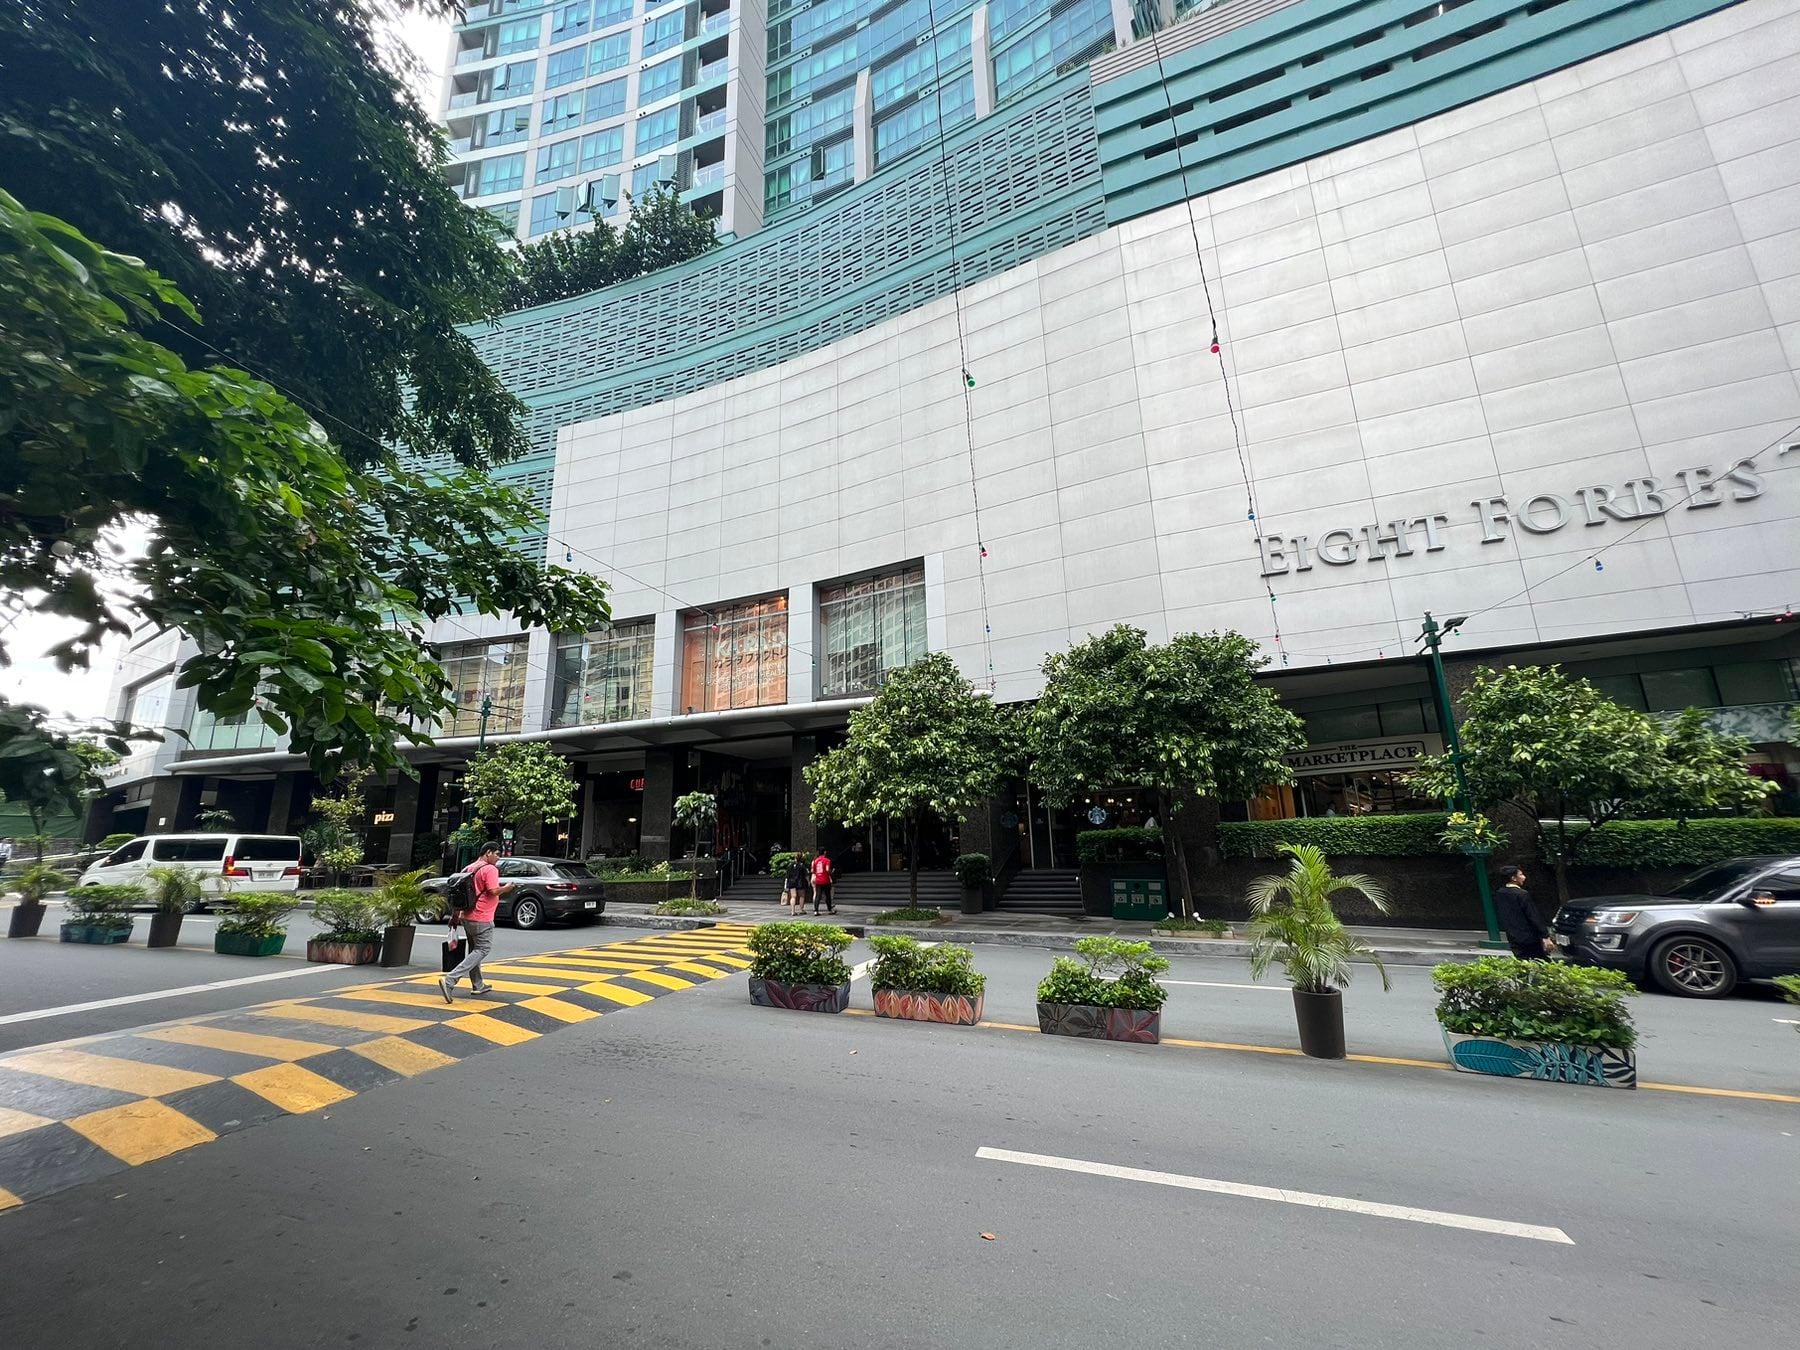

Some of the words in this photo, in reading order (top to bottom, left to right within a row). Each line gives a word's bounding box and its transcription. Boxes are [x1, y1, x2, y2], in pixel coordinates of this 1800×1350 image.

[1254, 513, 1449, 578] EIGHT
[1469, 457, 1768, 544] FORBES
[1287, 746, 1418, 768] MARKETPLACE
